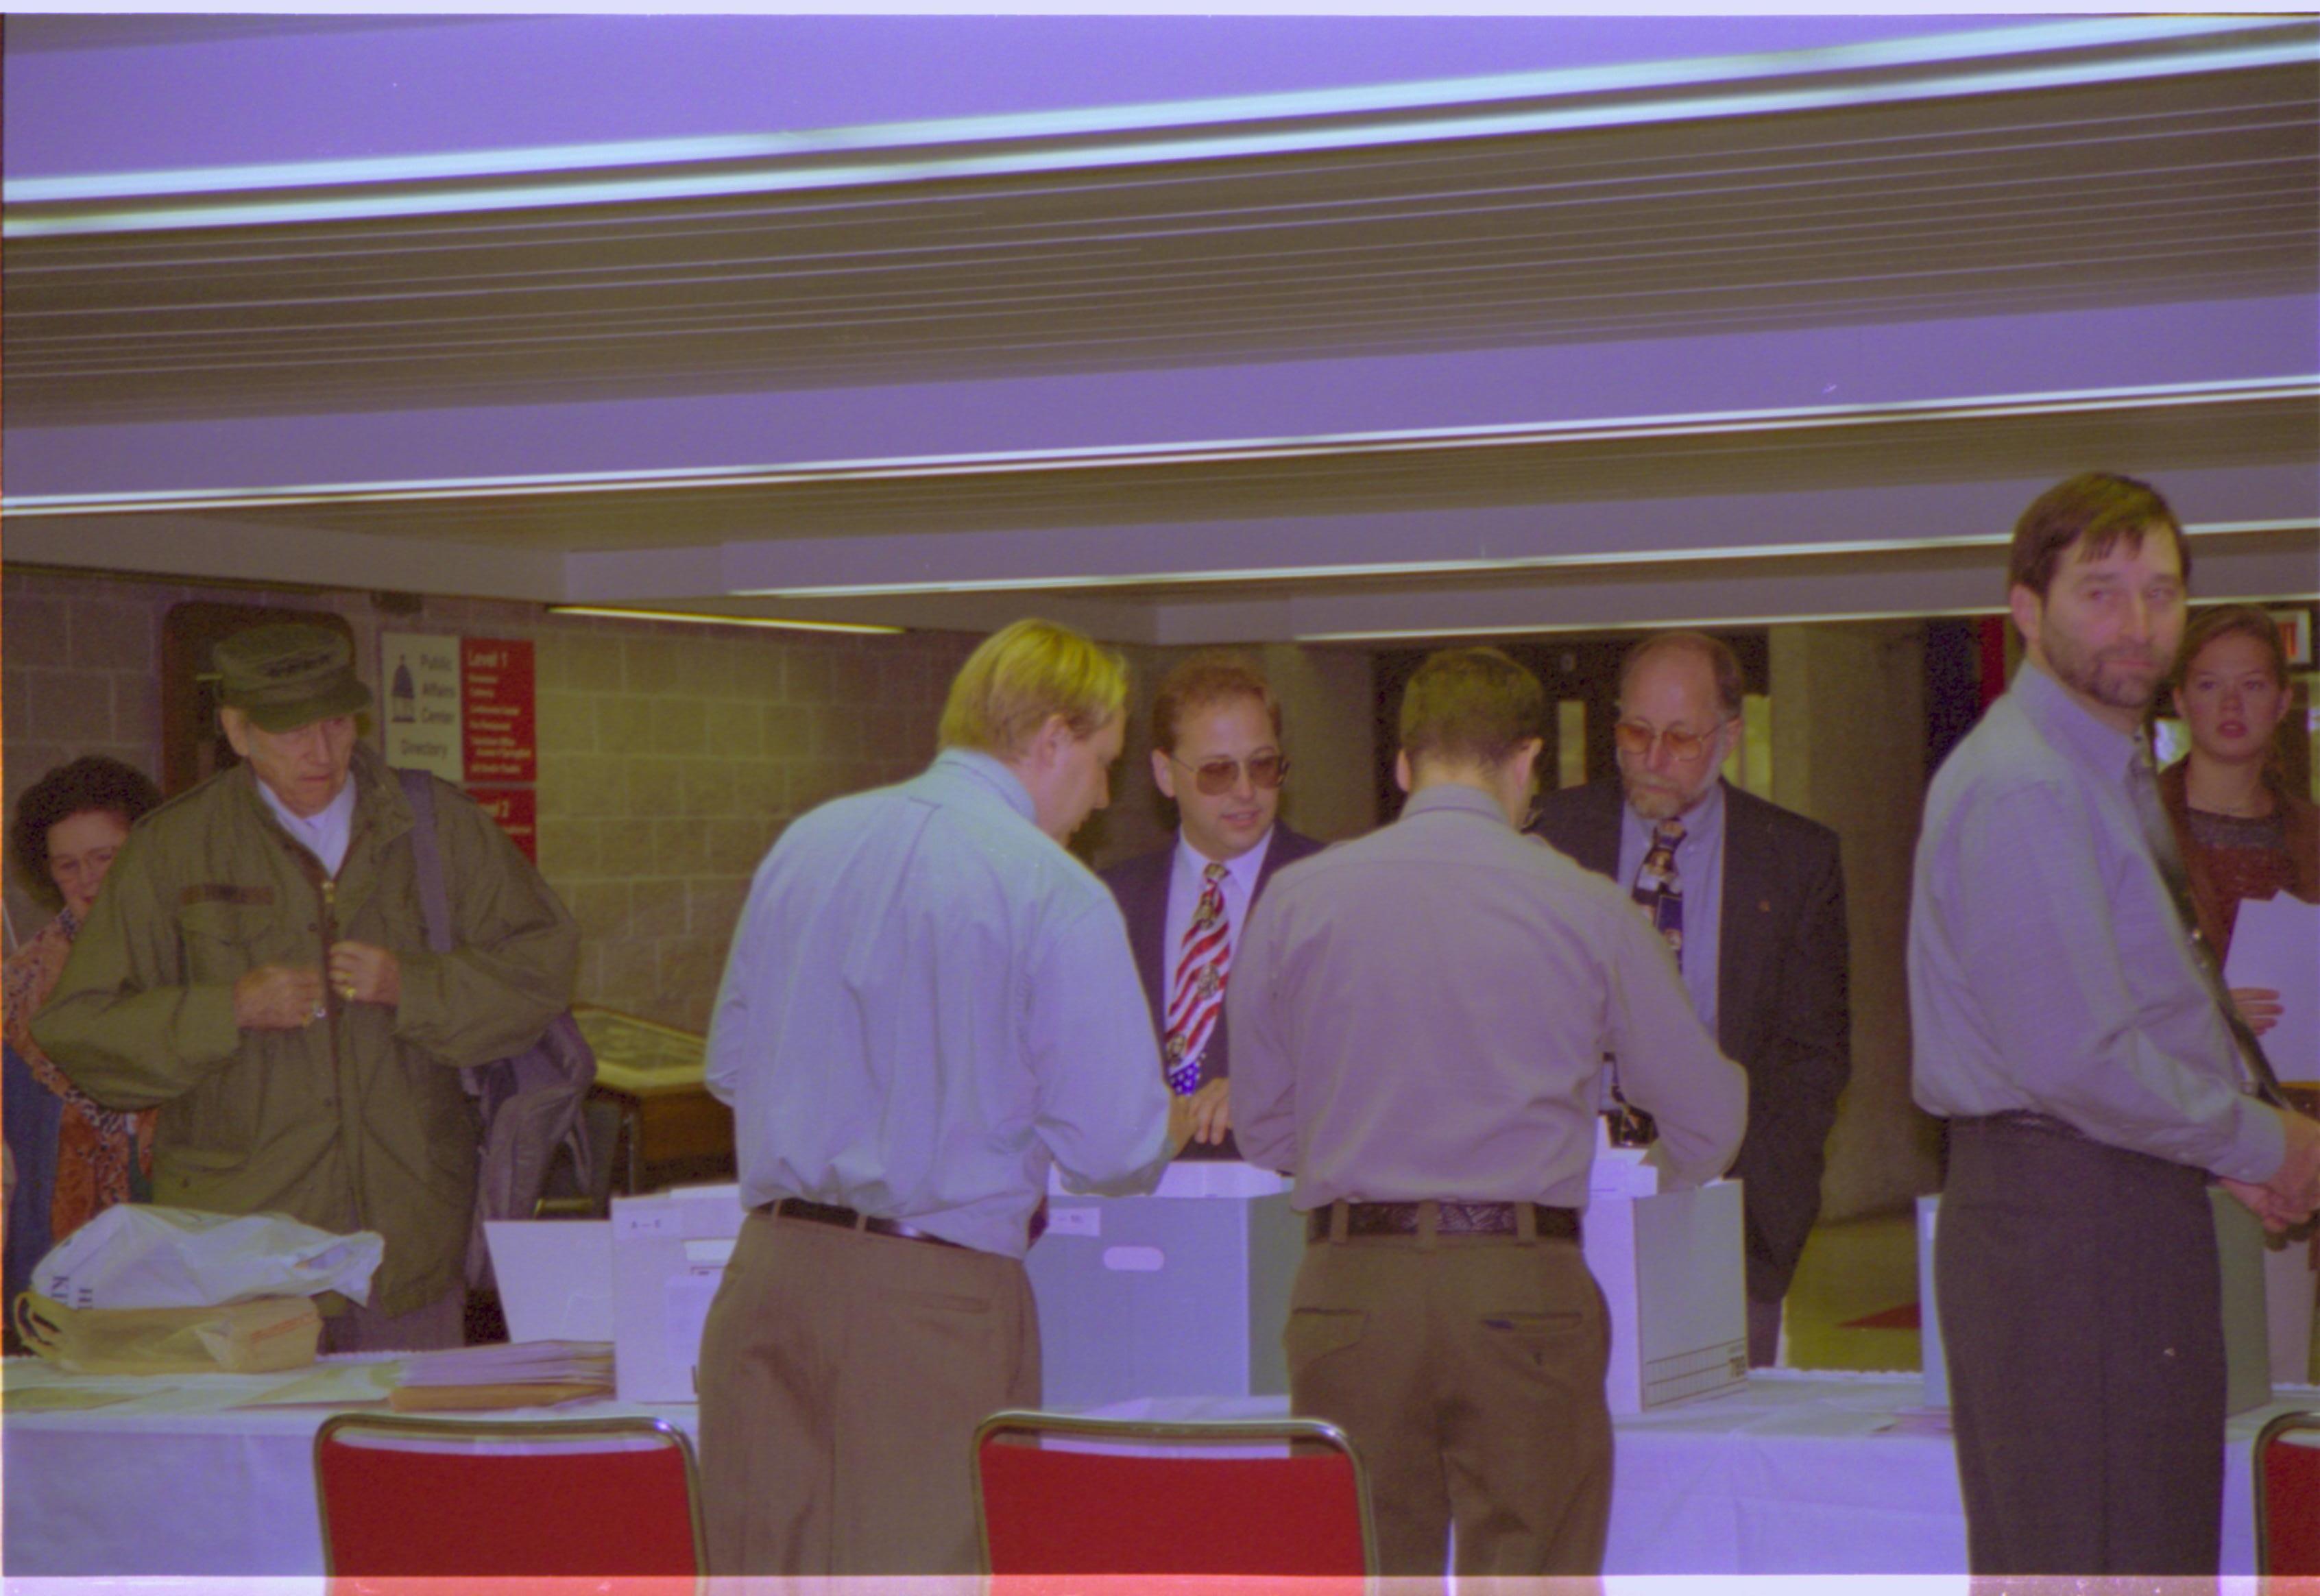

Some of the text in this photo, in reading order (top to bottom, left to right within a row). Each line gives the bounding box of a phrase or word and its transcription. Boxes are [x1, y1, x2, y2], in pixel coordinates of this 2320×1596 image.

[420, 654, 452, 672] Public
[467, 649, 508, 668] Level 1
[422, 681, 455, 698] Affairs
[422, 707, 455, 724] Center
[400, 738, 448, 760] Directory
